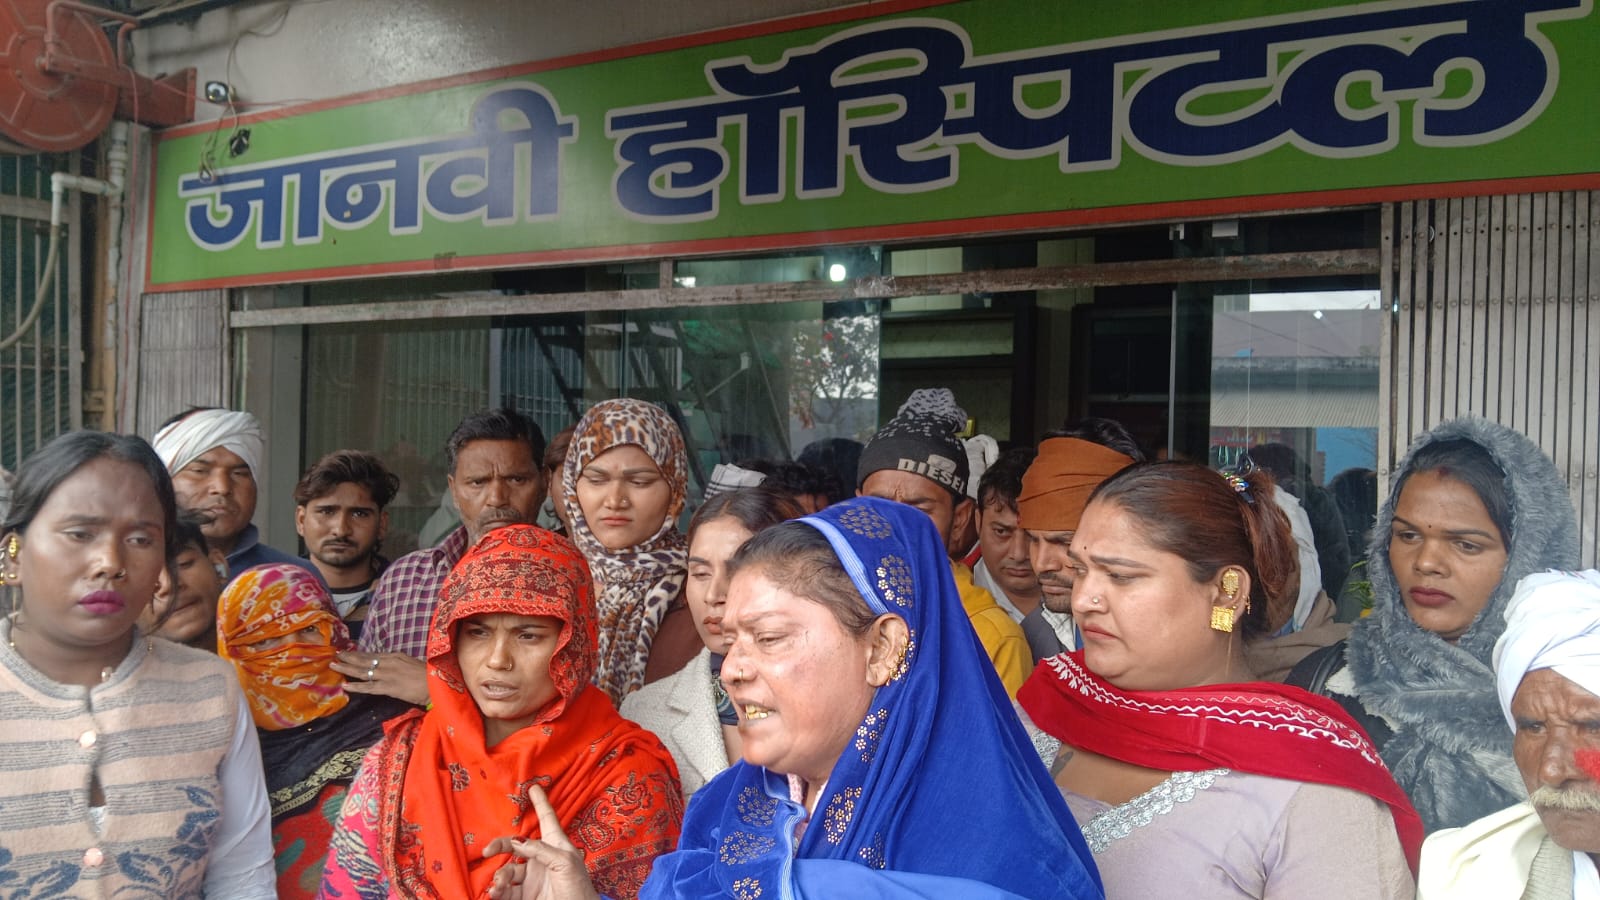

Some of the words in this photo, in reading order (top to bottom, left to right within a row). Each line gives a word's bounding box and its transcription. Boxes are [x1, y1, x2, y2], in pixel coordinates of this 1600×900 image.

[179, 82, 577, 250] जानवी
[606, 0, 1588, 223] हॉस्पिटल
[897, 458, 965, 495] DIESEL
